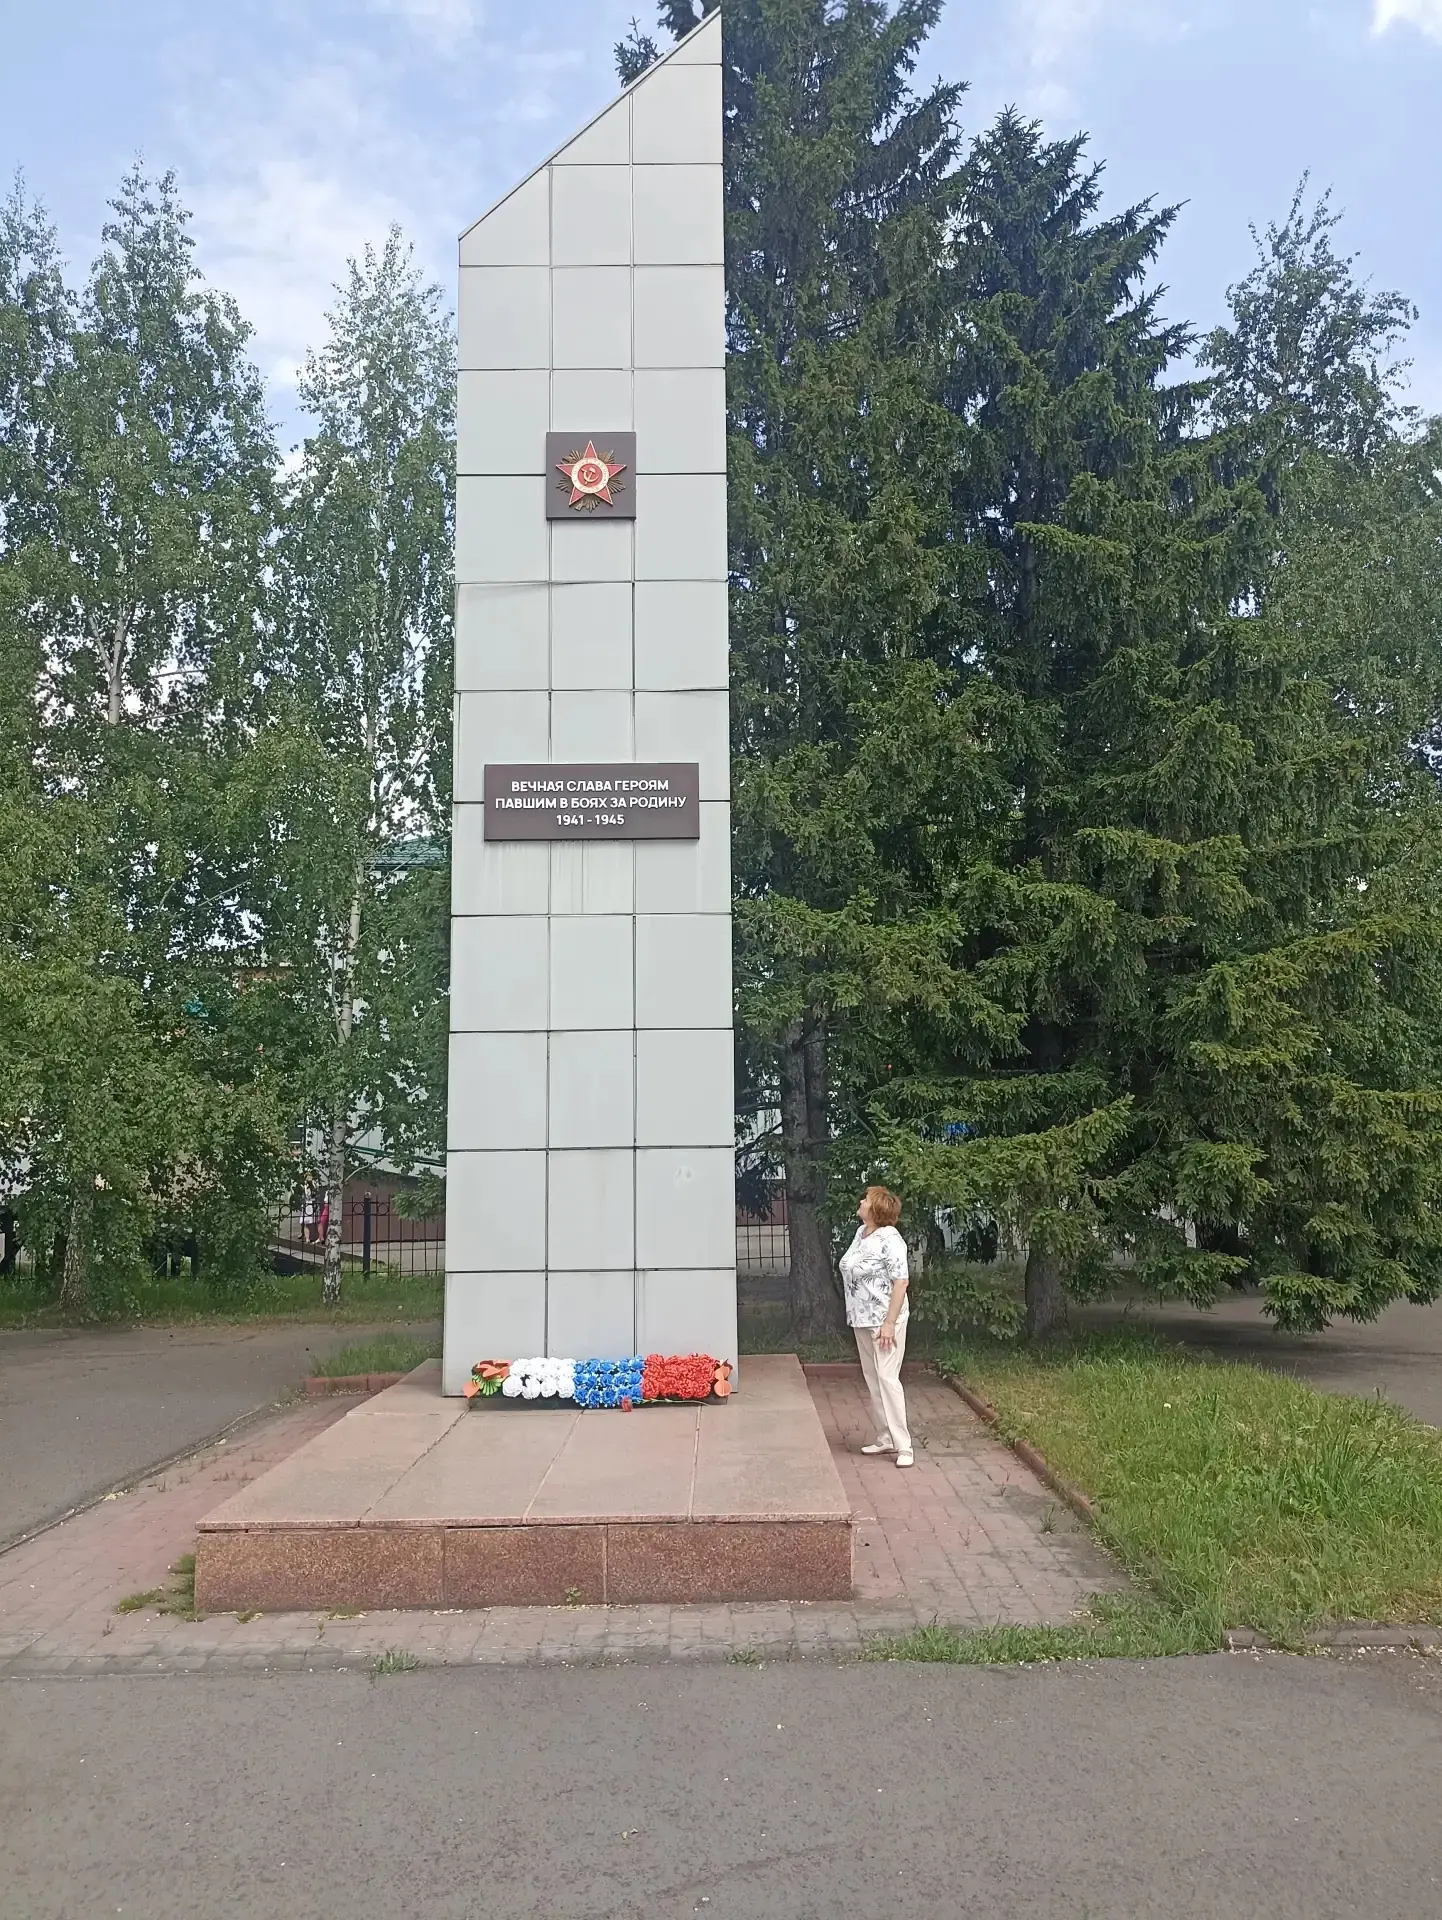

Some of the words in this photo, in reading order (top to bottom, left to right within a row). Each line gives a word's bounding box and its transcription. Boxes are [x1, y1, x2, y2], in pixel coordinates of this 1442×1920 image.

[512, 781, 564, 792] ВЕЧНАЯ
[567, 780, 612, 791] СЛАВА
[615, 780, 669, 791] ГЕРОЯМ
[496, 798, 556, 809] ПАВШИМ
[560, 798, 568, 808] В
[571, 797, 606, 808] БОЯХ
[610, 797, 627, 808] ЗА
[630, 796, 686, 808] РОДИНУ
[557, 815, 584, 825] 1941
[595, 814, 624, 824] 1945
